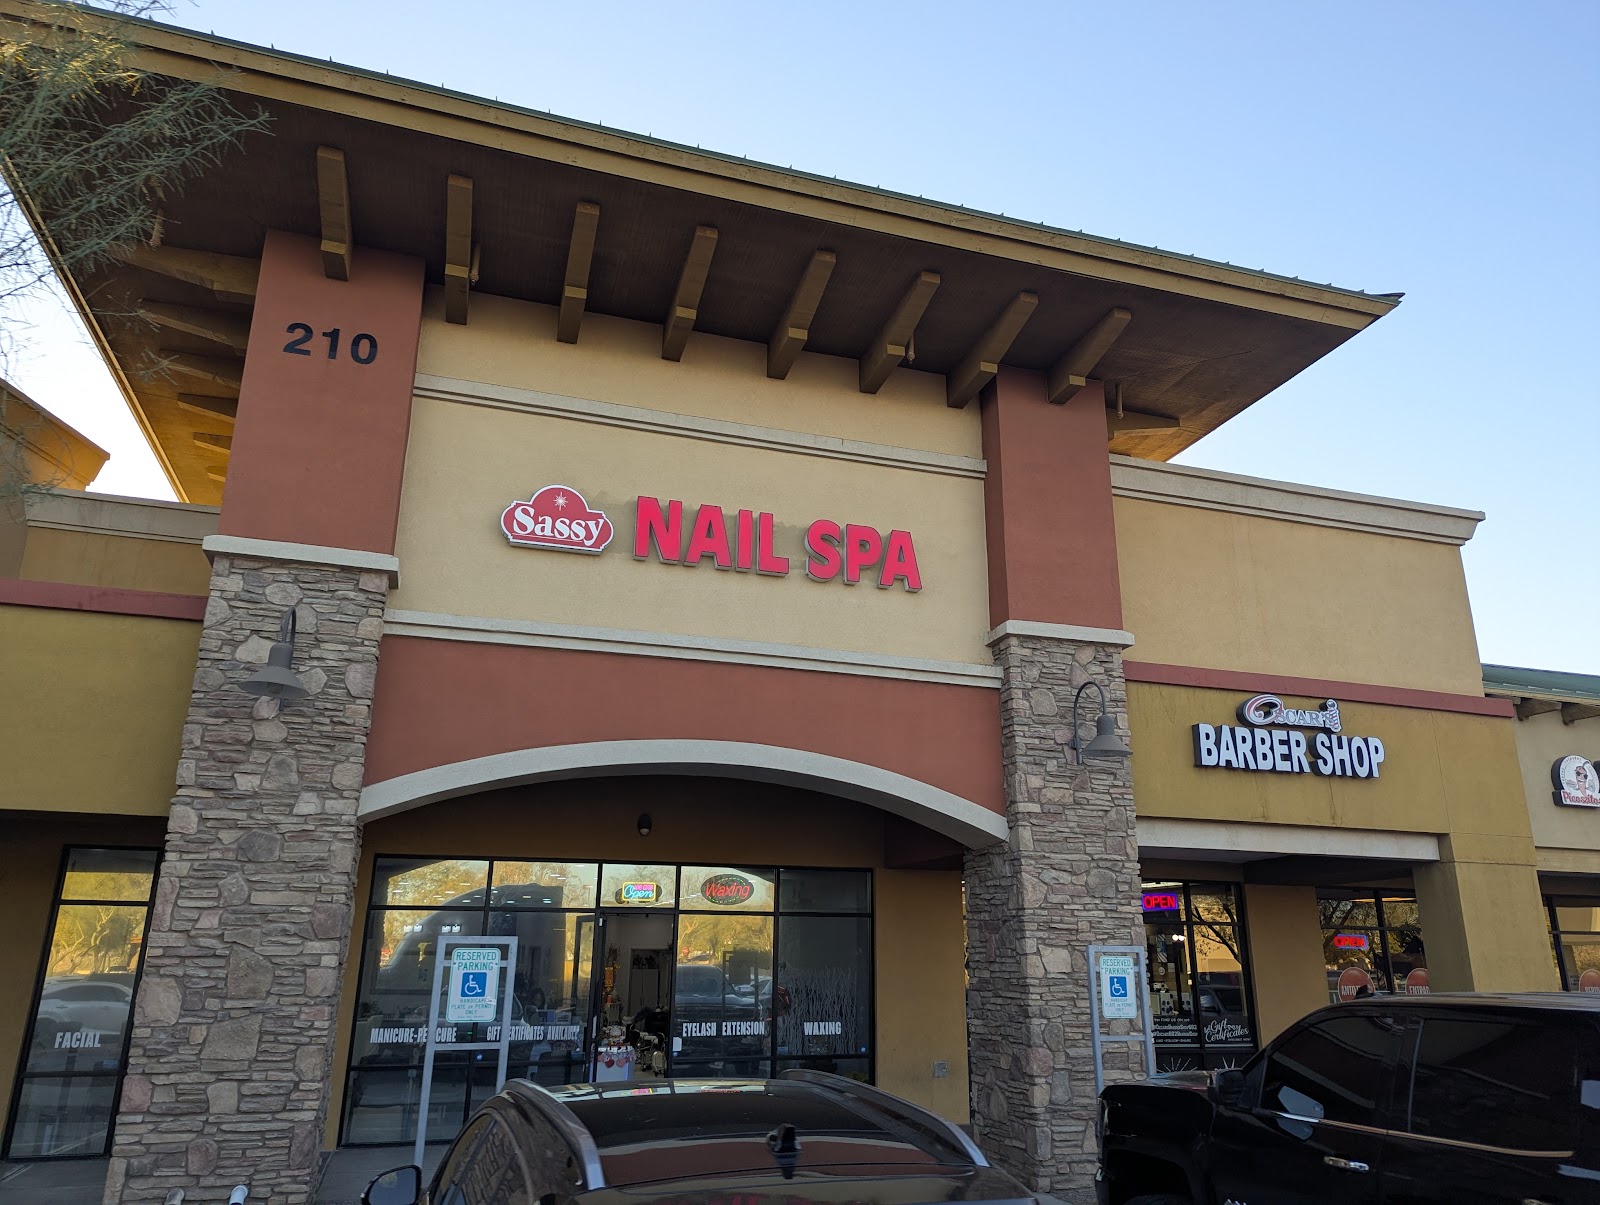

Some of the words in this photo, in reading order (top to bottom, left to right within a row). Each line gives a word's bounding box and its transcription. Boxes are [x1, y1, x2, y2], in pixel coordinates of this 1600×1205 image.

[283, 322, 378, 365] 210
[513, 505, 605, 547] Sassy
[634, 495, 790, 576] NAIL
[804, 519, 923, 593] SPA
[1197, 723, 1312, 774] BARBER
[1314, 732, 1386, 779] SHOP
[623, 884, 654, 899] Open
[705, 880, 751, 899] Waxing
[1144, 895, 1176, 909] OPEN
[1334, 936, 1366, 948] OPEN
[456, 951, 497, 961] RESERVED
[457, 962, 494, 971] PARKING
[1104, 967, 1130, 975] PARKING
[486, 1025, 502, 1041] GIFT
[508, 1025, 544, 1041] ERTIFICATES
[546, 1025, 580, 1041] AVAILABLE
[682, 1022, 717, 1037] EYELASH
[722, 1021, 765, 1036] EXTENSION
[804, 1021, 842, 1036] WAXING
[1210, 1018, 1228, 1034] Gift
[54, 1031, 102, 1049] FACIAL
[370, 1027, 457, 1044] MANICURE-PECURE
[1205, 1027, 1250, 1042] Certificates
